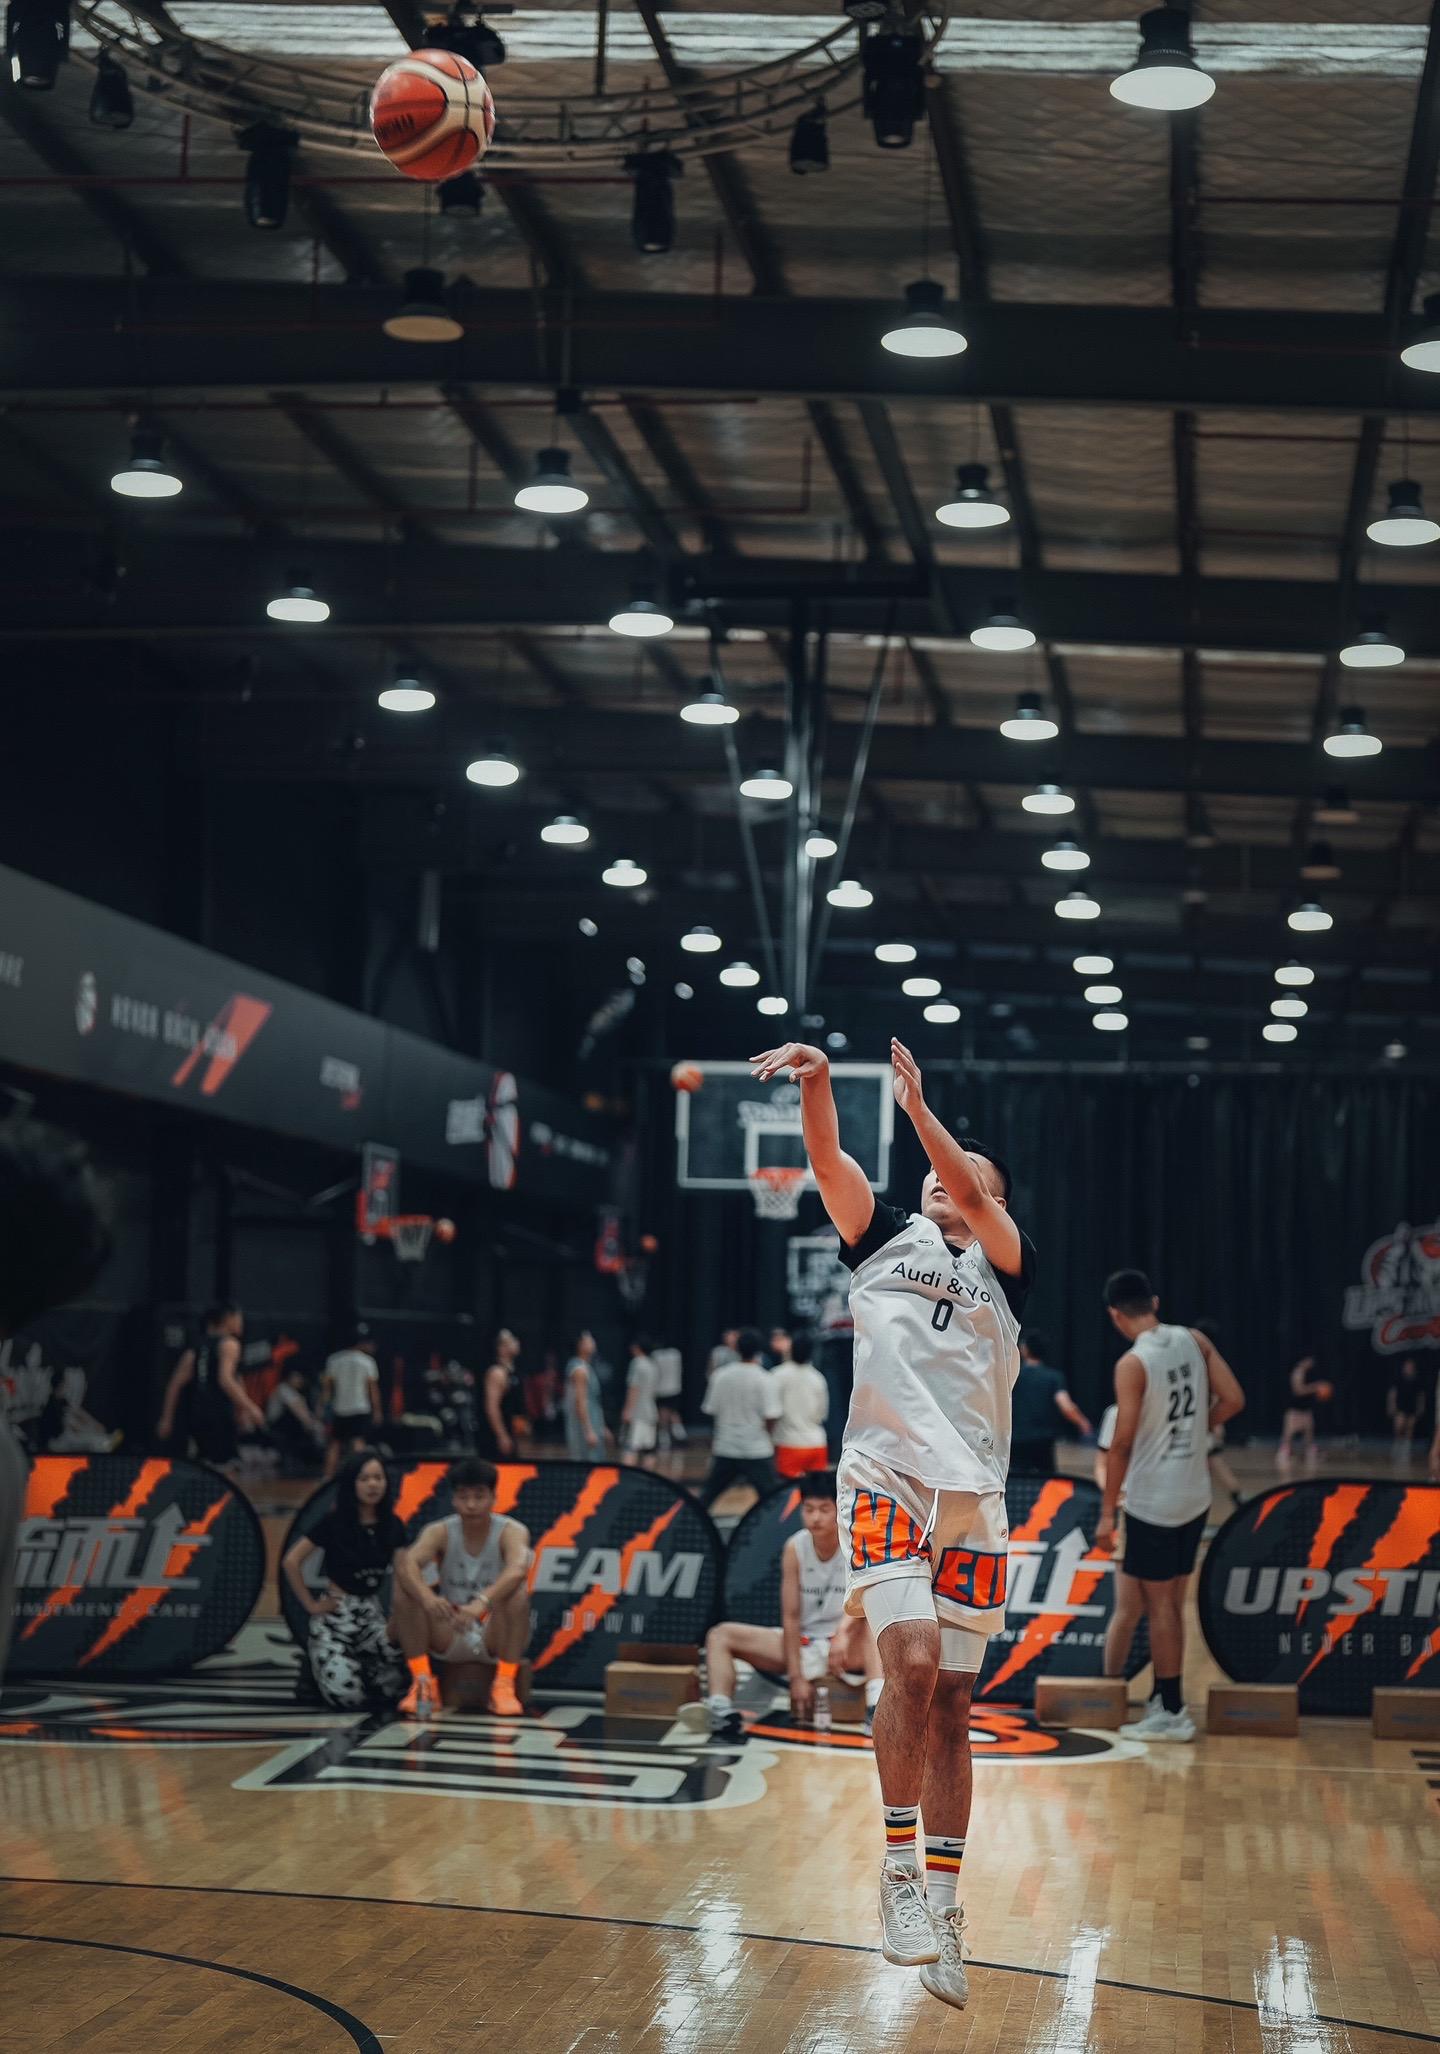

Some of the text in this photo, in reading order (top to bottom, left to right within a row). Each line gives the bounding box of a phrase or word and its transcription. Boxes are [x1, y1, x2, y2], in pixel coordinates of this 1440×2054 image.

[891, 1262, 942, 1288] Audi
[931, 1298, 953, 1332] 0
[1168, 1385, 1196, 1421] 22
[1279, 1632, 1374, 1655] NEVER
